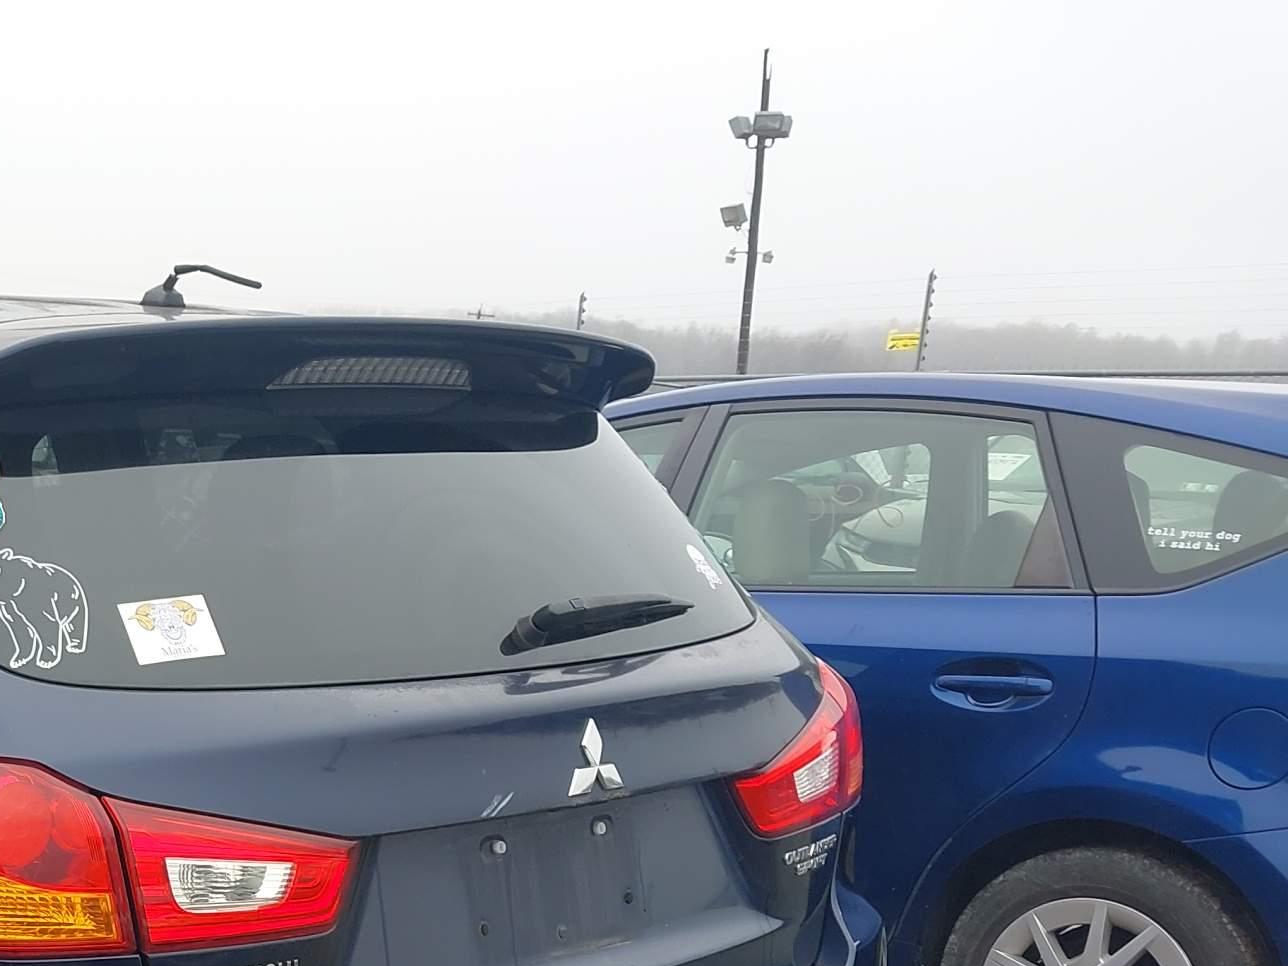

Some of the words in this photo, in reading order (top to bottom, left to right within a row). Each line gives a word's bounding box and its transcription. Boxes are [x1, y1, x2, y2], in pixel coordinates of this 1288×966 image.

[1147, 526, 1176, 537] tell
[1179, 529, 1213, 540] your
[1215, 530, 1243, 543] dog
[1158, 539, 1167, 548] i
[1169, 541, 1202, 550] said
[1204, 542, 1221, 551] hi
